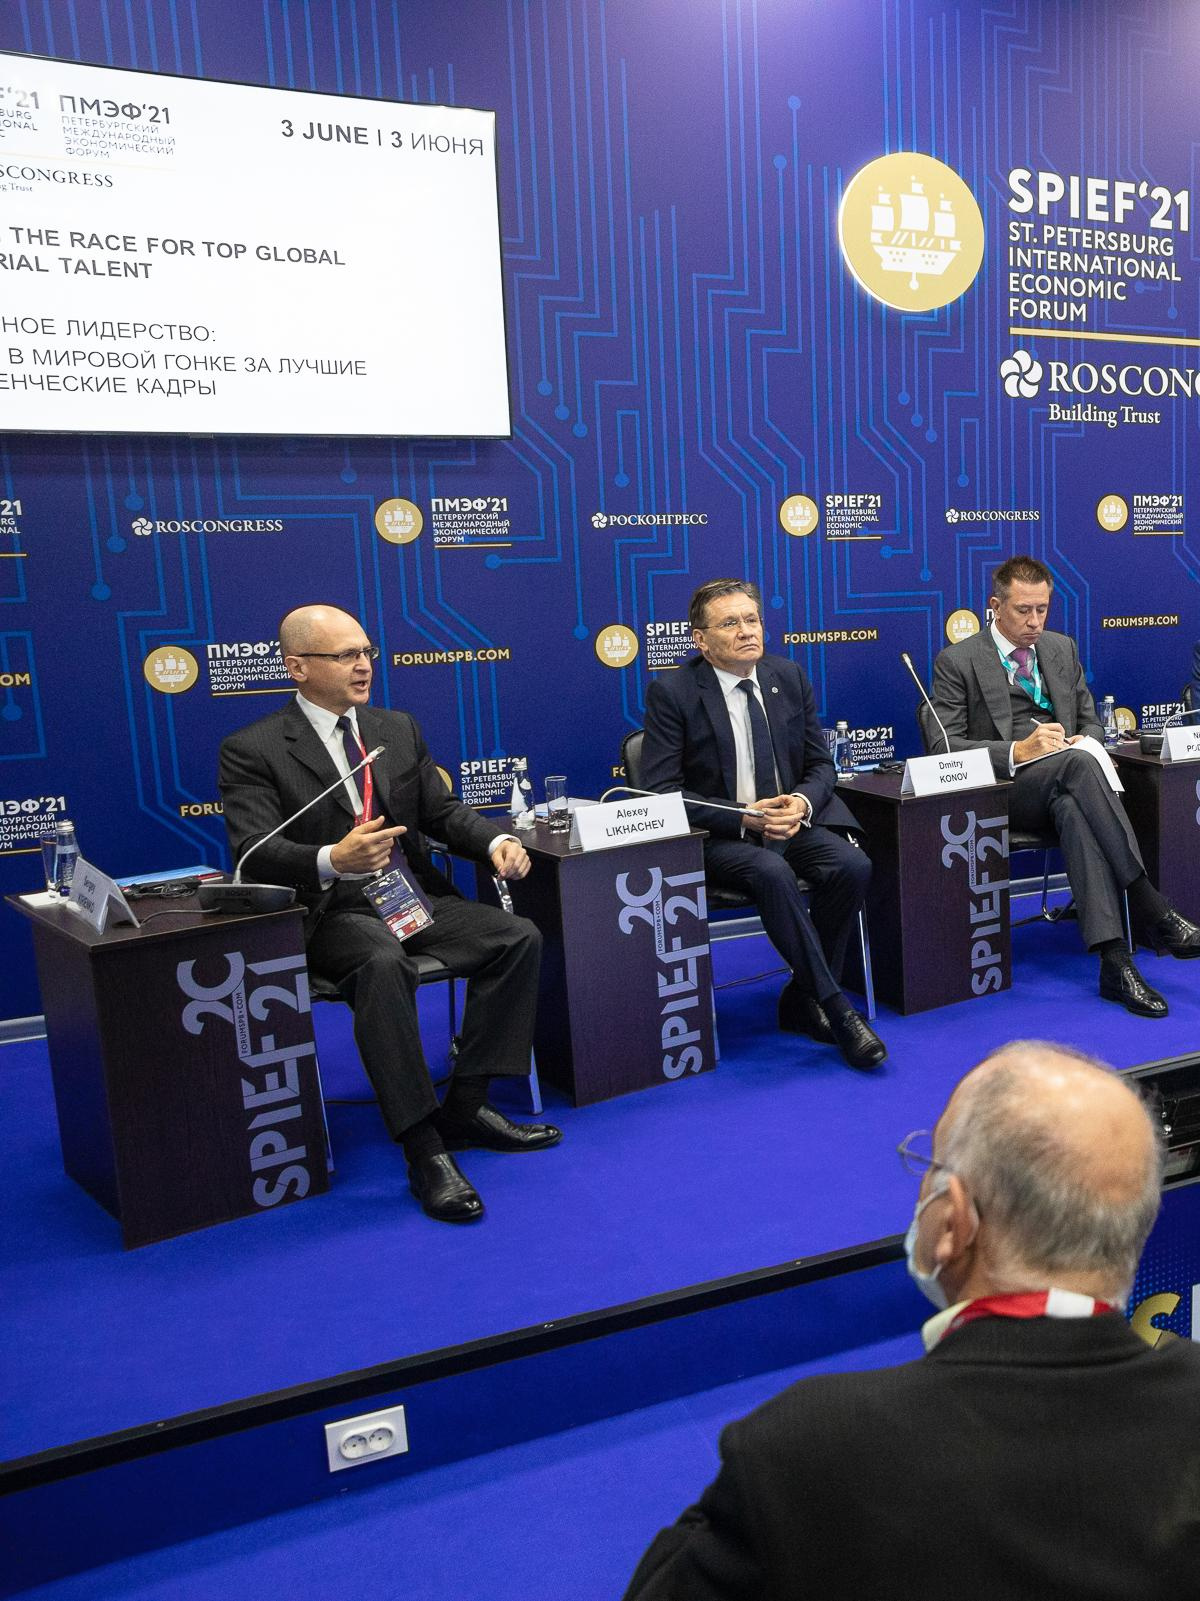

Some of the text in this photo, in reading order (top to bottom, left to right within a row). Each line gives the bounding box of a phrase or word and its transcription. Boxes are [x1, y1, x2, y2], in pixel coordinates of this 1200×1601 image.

[59, 94, 170, 124] ПМЭФ'21
[61, 116, 158, 134] ПЕТЕРБУРГСКИЙ
[63, 126, 175, 145] МЕЖДУНАРОДНЫЙ
[281, 119, 484, 156] 3 JUNE 3 ИЮНЯ
[64, 137, 174, 155] ЭКОНОМИЧЕСКИЙ
[65, 147, 110, 158] ФОРУМ
[1008, 167, 1190, 233] SPIEF'21
[10, 226, 346, 266] THE RACE FOR TOP GLOBAL
[1008, 221, 1174, 258] ST. PETERSBURG
[58, 257, 153, 280] TALENT
[1008, 246, 1182, 282] INTERNATIONAL
[1008, 272, 1128, 301] ECONOMIC
[1008, 297, 1088, 323] FORUM
[2, 316, 217, 343] НОЕ ЛИДЕРСТВО:
[8, 348, 367, 377] В МИРОВОЙ ГОНКЕ ЗА ЛУЧШИЕ
[137, 377, 217, 398] КАДРЫ
[1048, 403, 1161, 429] Building Trust
[431, 497, 507, 512] ПМЭФ'21
[826, 494, 881, 507] SPIEF'21
[1134, 495, 1182, 506] ПМЭФ'21
[433, 512, 498, 520] ПЕТЕРБУРГСКИЙ
[609, 512, 708, 526] РОСКОНГРЕСС
[960, 509, 1040, 522] ROSCONGRESS
[156, 519, 283, 533] ROSCONGRESS
[433, 520, 510, 528] МЕЖДУНАРОДНЫЙ
[433, 527, 508, 535] ЭКОНОМИЧЕСКИЙ
[1103, 615, 1179, 628] FORUMSPB.COM
[647, 637, 660, 645] ST.
[784, 629, 877, 644] FORUMSPB.COM
[209, 656, 283, 667] ПЕТЕРБУРГСКИЙ
[393, 648, 510, 666] FORUMSPB.COM
[647, 650, 687, 659] ECONOMIC
[647, 658, 674, 666] FORUM
[1142, 703, 1185, 716] SPIEF'21
[939, 760, 963, 769] Dmitry
[940, 772, 968, 783] KONOV
[463, 788, 505, 798] ECONOMIC
[463, 797, 492, 805] FORUM
[616, 807, 649, 819] Alexey
[606, 818, 665, 838] LIKHACHEV
